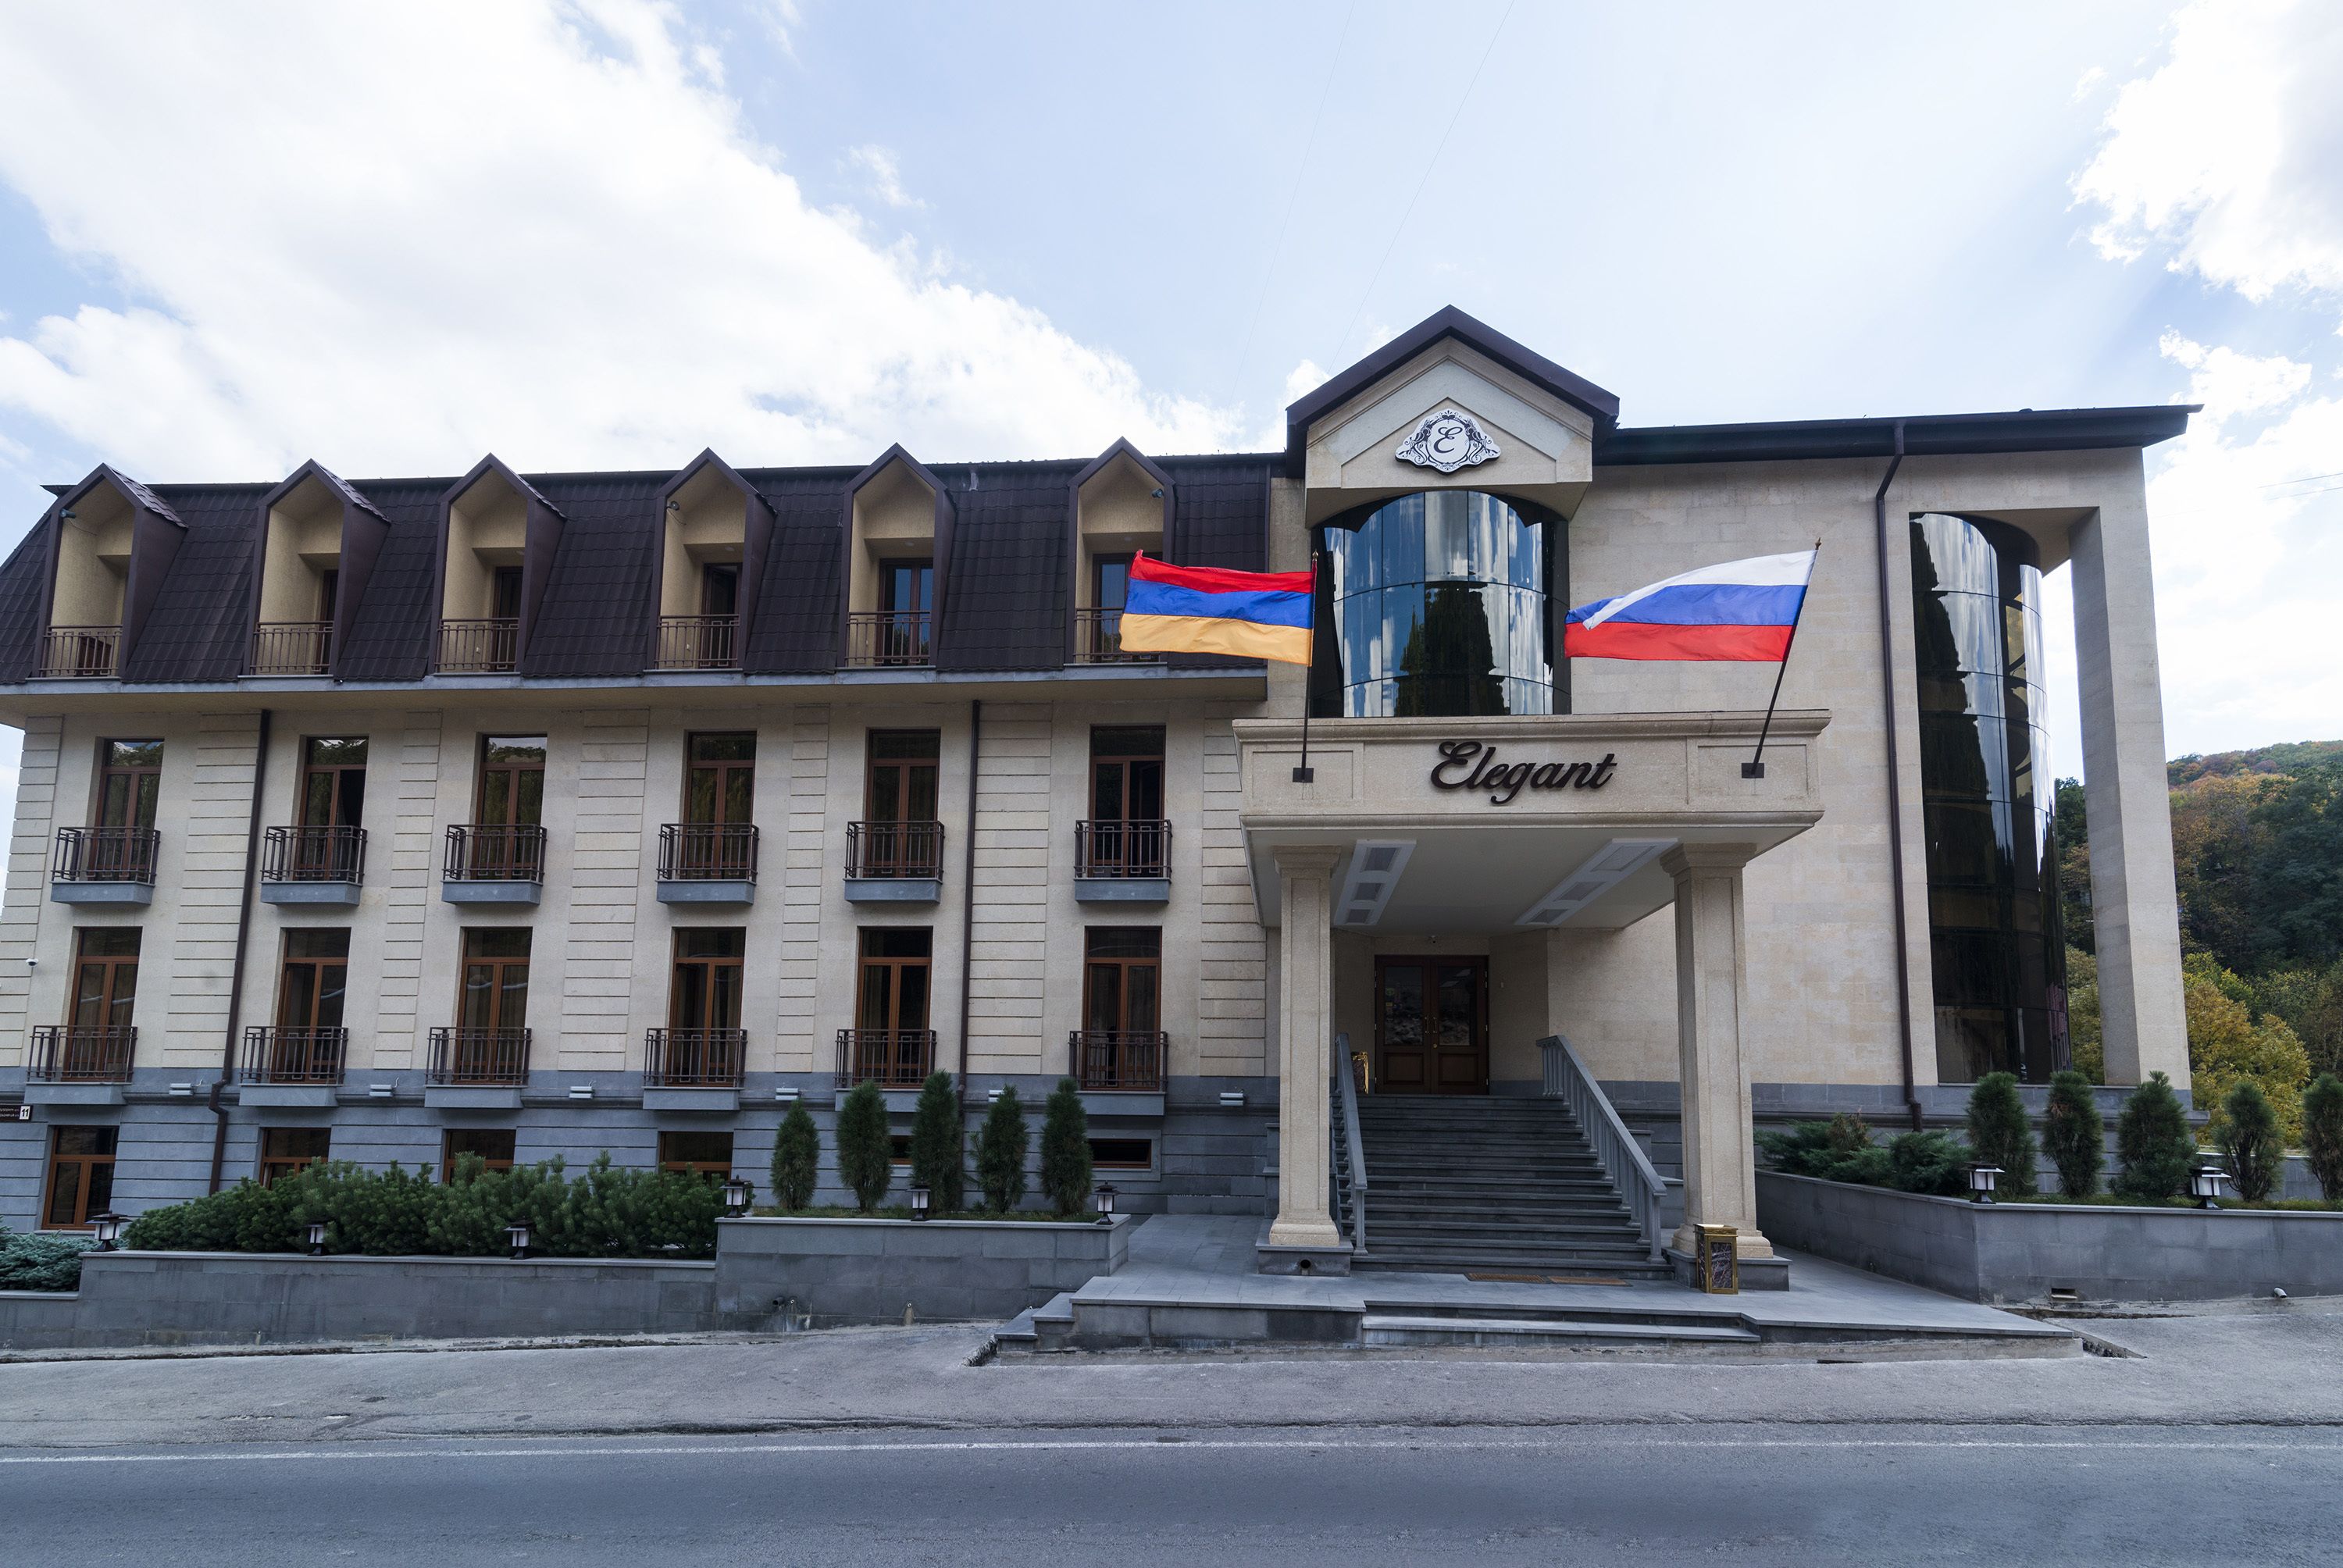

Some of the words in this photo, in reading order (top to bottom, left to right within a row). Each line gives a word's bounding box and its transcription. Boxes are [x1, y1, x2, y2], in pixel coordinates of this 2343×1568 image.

[1432, 426, 1464, 454] E
[1431, 741, 1617, 805] Elegant
[21, 1108, 29, 1117] 11
